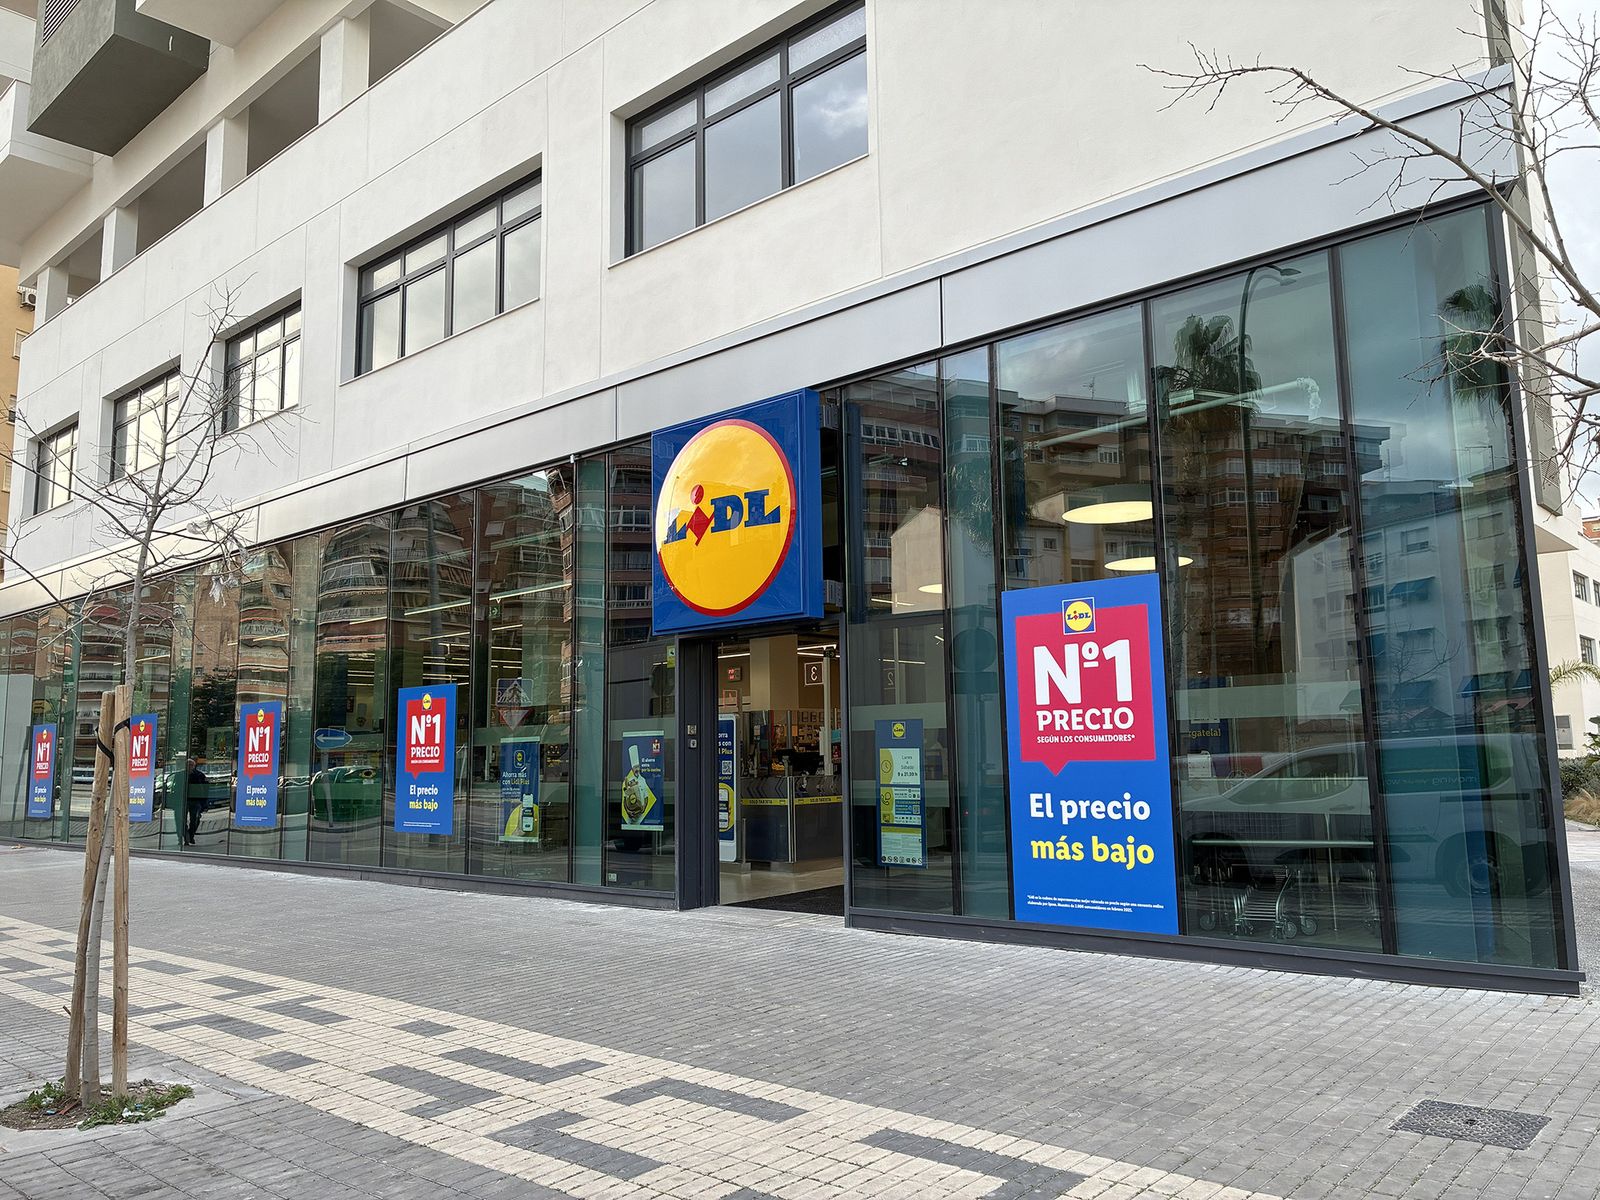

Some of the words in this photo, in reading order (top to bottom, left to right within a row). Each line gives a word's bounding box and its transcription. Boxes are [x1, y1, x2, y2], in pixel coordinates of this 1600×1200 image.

[664, 484, 781, 546] LIDL
[1067, 610, 1090, 620] LIDL
[1034, 640, 1132, 705] Nº1
[1036, 707, 1134, 731] PRECIO
[1037, 735, 1059, 743] SEGÚN
[248, 753, 269, 763] PRECIO
[411, 746, 440, 757] PRECIO
[252, 785, 267, 796] precio
[410, 784, 416, 795] El
[417, 784, 438, 797] precio
[256, 797, 267, 808] bajo
[409, 799, 422, 809] más
[423, 799, 438, 812] bajo
[1030, 793, 1054, 818] El
[1060, 792, 1150, 824] precio
[1031, 835, 1084, 861] más
[1092, 835, 1154, 870] bajo
